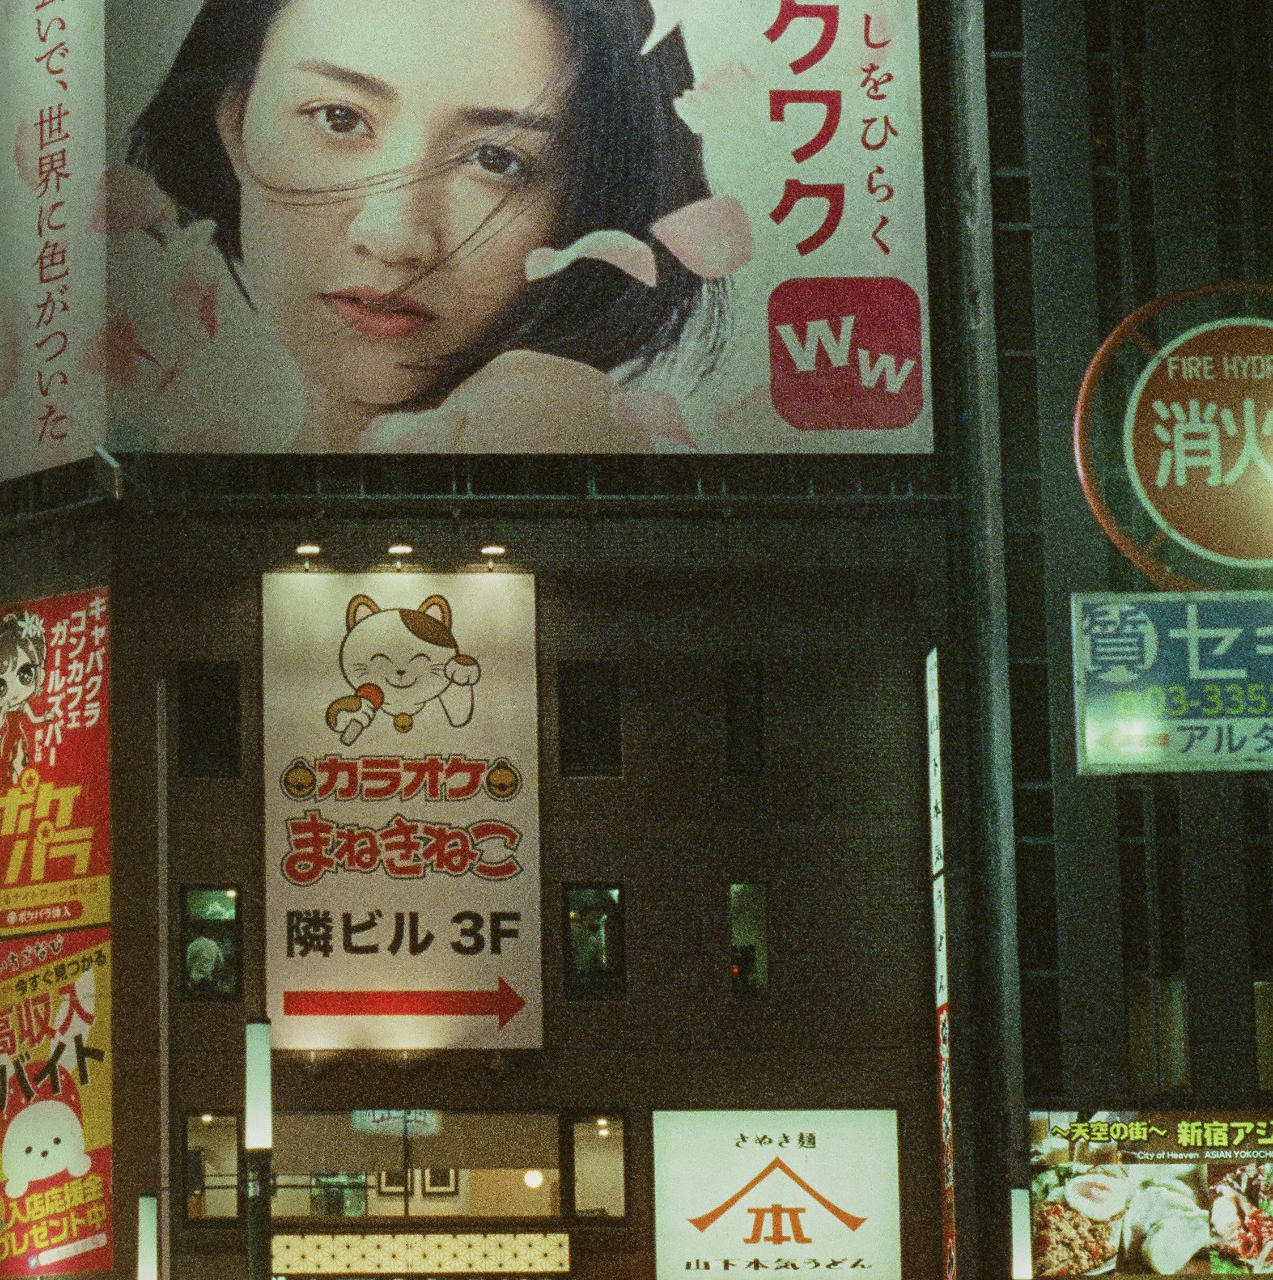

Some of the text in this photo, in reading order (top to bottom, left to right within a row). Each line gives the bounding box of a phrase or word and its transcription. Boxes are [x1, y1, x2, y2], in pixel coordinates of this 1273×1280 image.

[1167, 356, 1214, 380] FIRE
[66, 610, 87, 730] コンカフェ
[83, 595, 107, 729] キャバクラ
[44, 618, 70, 767] ガールズバー
[1144, 684, 1273, 716] 03-335
[313, 755, 487, 802] カラオケ
[281, 809, 524, 886] まねきねこ
[285, 909, 522, 958] 隣ビル 3F
[1137, 1151, 1154, 1160] City
[1156, 1151, 1165, 1159] of
[1167, 1151, 1199, 1159] Heaven
[1204, 1150, 1231, 1159] ASIAN
[684, 1257, 873, 1272] 山下本気うどん
